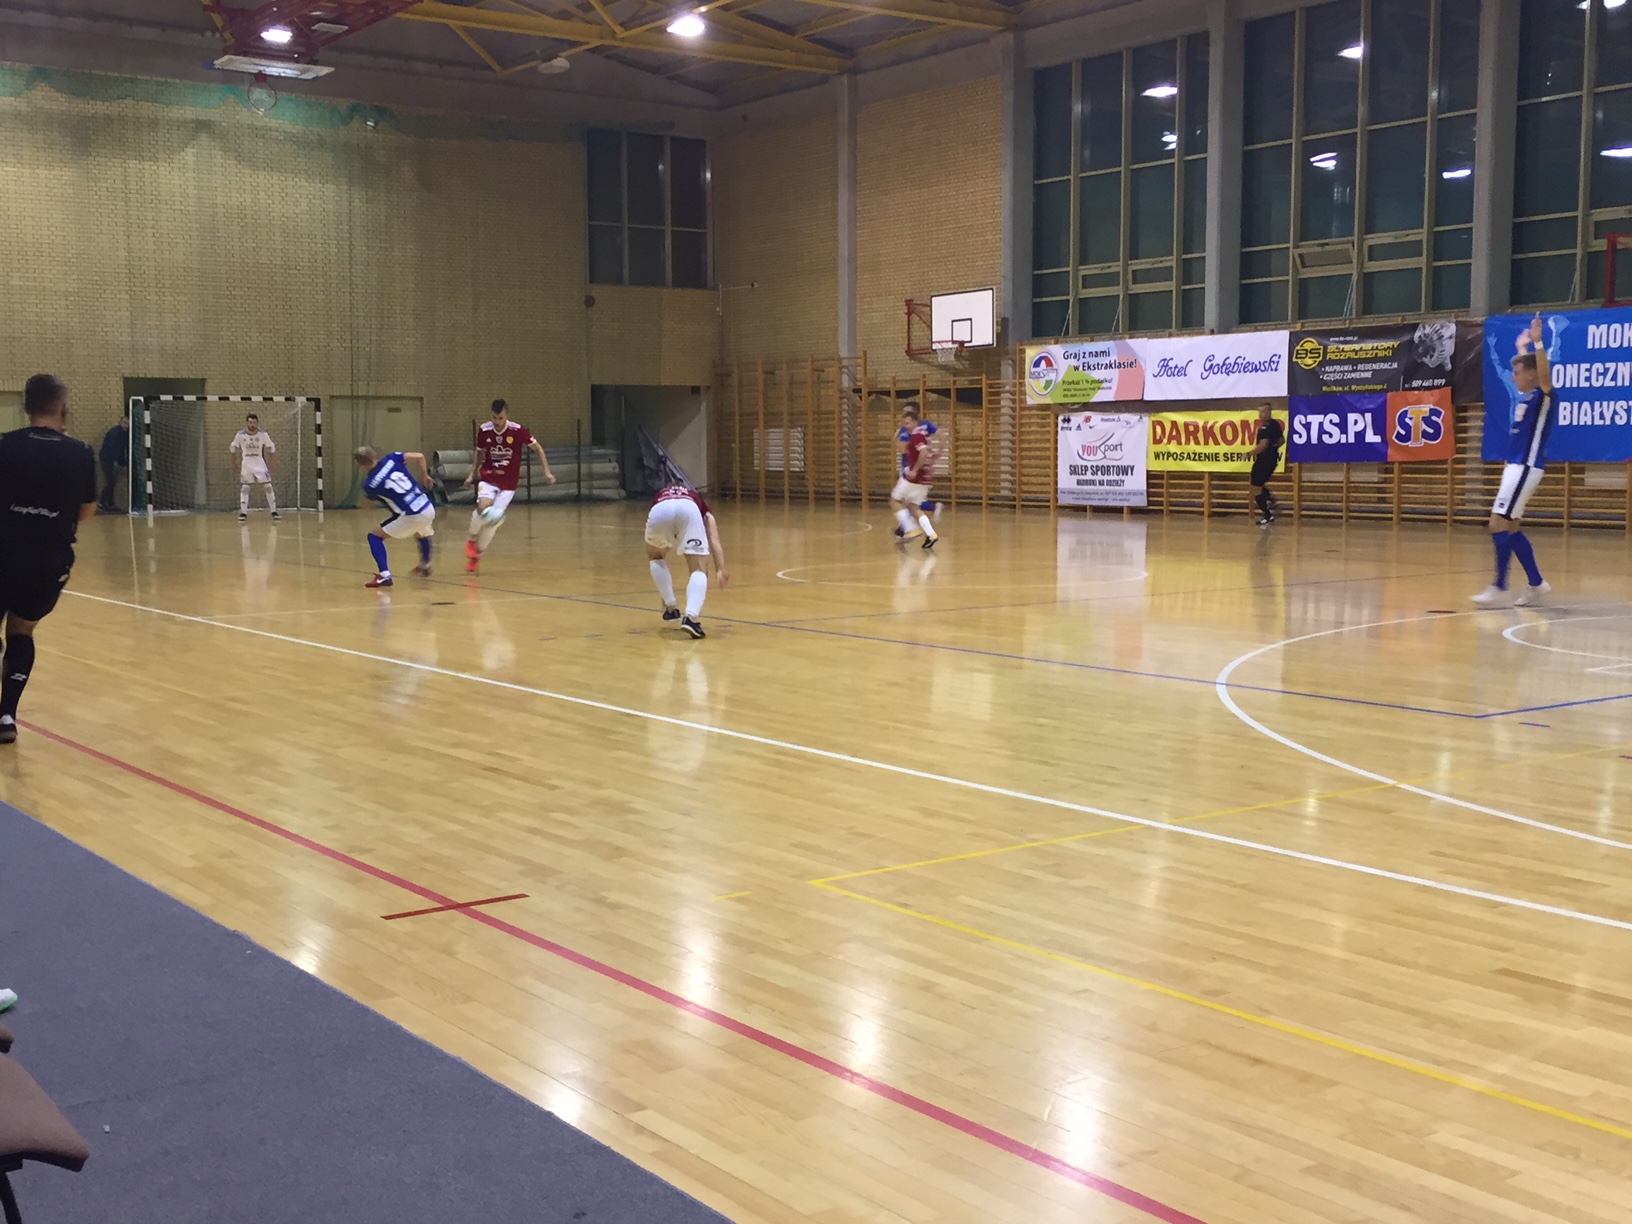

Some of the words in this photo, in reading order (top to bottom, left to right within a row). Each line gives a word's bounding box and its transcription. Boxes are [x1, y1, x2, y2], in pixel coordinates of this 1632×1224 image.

[1326, 341, 1401, 352] ALTERNATORY
[1063, 350, 1081, 362] Graj
[1088, 347, 1111, 358] nami
[1295, 348, 1322, 360] BS
[1326, 349, 1393, 361] ROZRUSZNIKI
[1082, 358, 1137, 371] Ekstraklasie!
[1153, 357, 1193, 378] Hotel
[1200, 353, 1281, 380] Gołębiewski
[1551, 361, 1632, 389] ONECZN
[1292, 412, 1382, 445] STS.PL
[1392, 404, 1445, 447] STS
[1153, 449, 1220, 462] WYPOSAŻENIE
[1068, 464, 1089, 477] SKLEP
[1090, 464, 1135, 477] SPORTOWY
